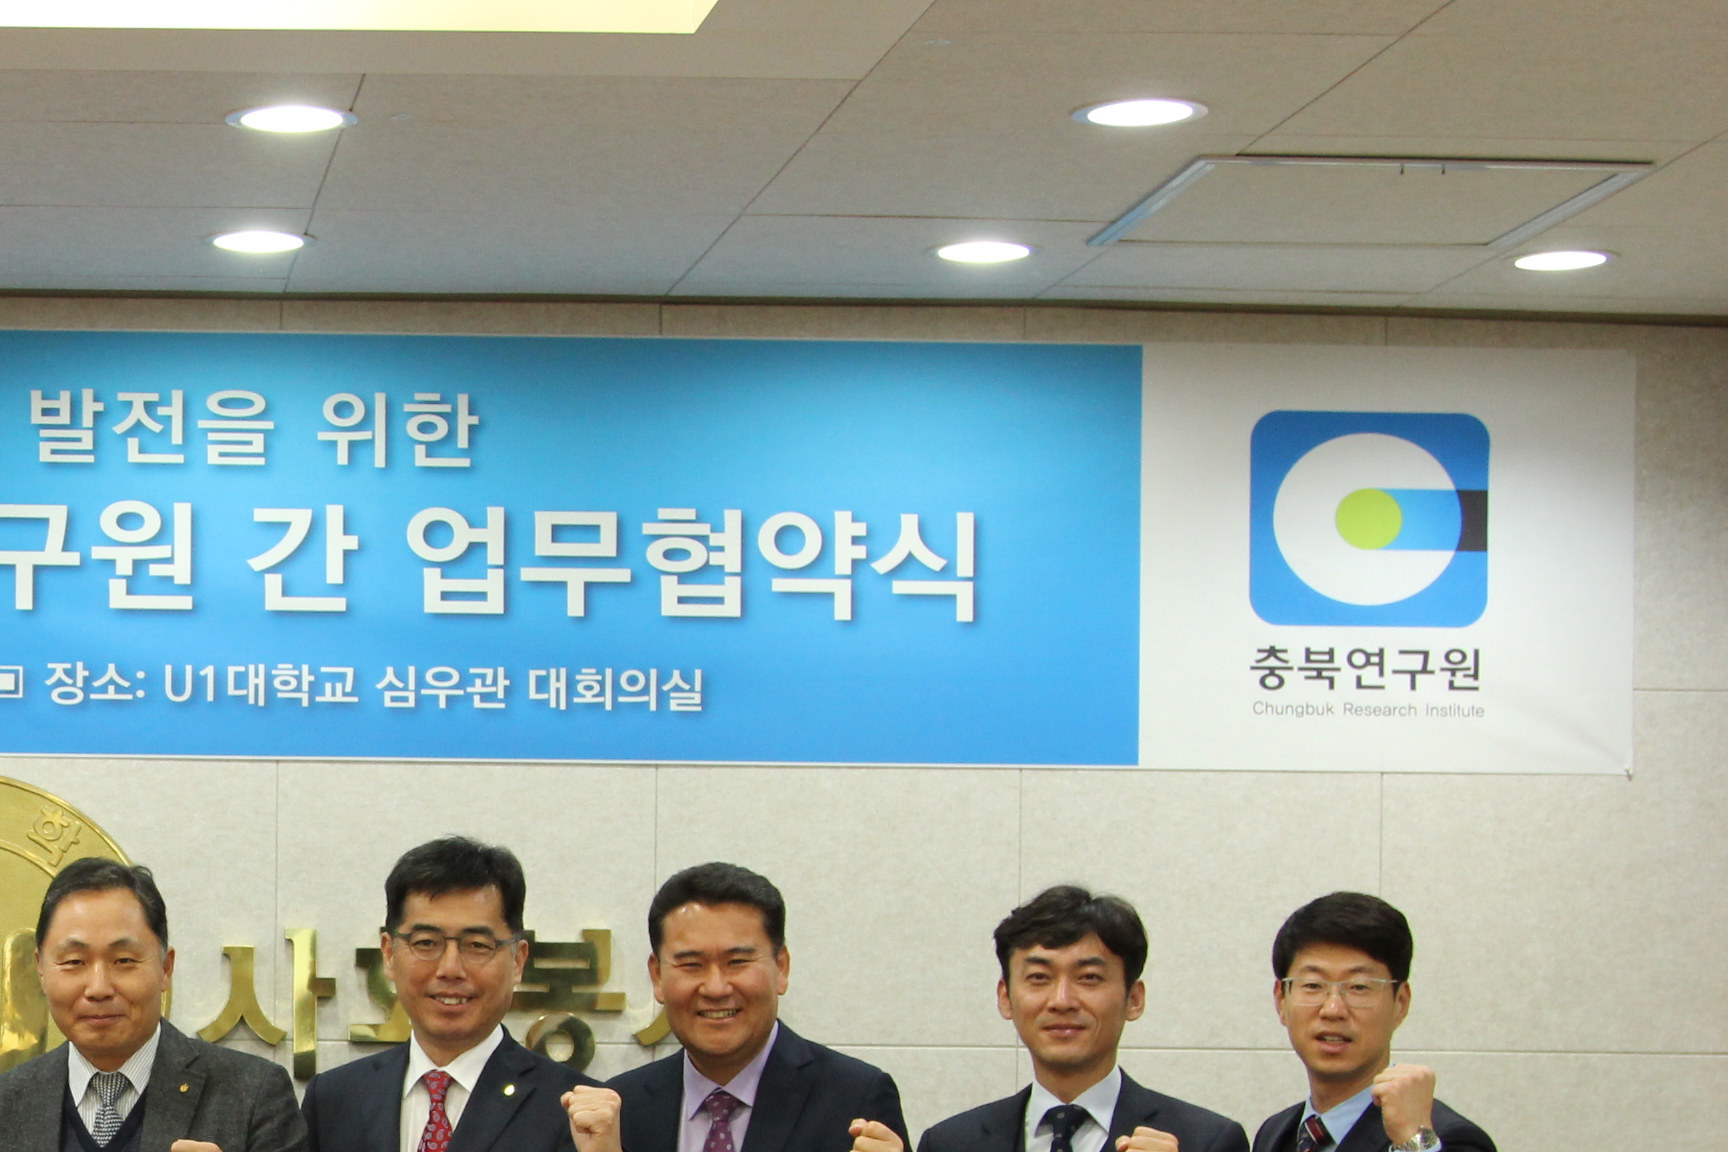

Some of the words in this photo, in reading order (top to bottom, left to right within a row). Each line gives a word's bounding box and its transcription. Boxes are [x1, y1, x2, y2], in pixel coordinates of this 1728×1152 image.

[31, 388, 275, 466] 발전을
[317, 392, 479, 468] 위한
[246, 503, 359, 612] 간
[406, 506, 975, 622] 업무협약식
[45, 661, 146, 705] 장소:
[164, 663, 359, 707] U1대학교
[375, 665, 510, 709] 심우관
[529, 667, 704, 711] 대회의실
[1250, 645, 1479, 691] 충북연구원
[1252, 701, 1335, 718] Chungbuk
[1343, 702, 1418, 717] Research
[1425, 704, 1485, 718] Institute
